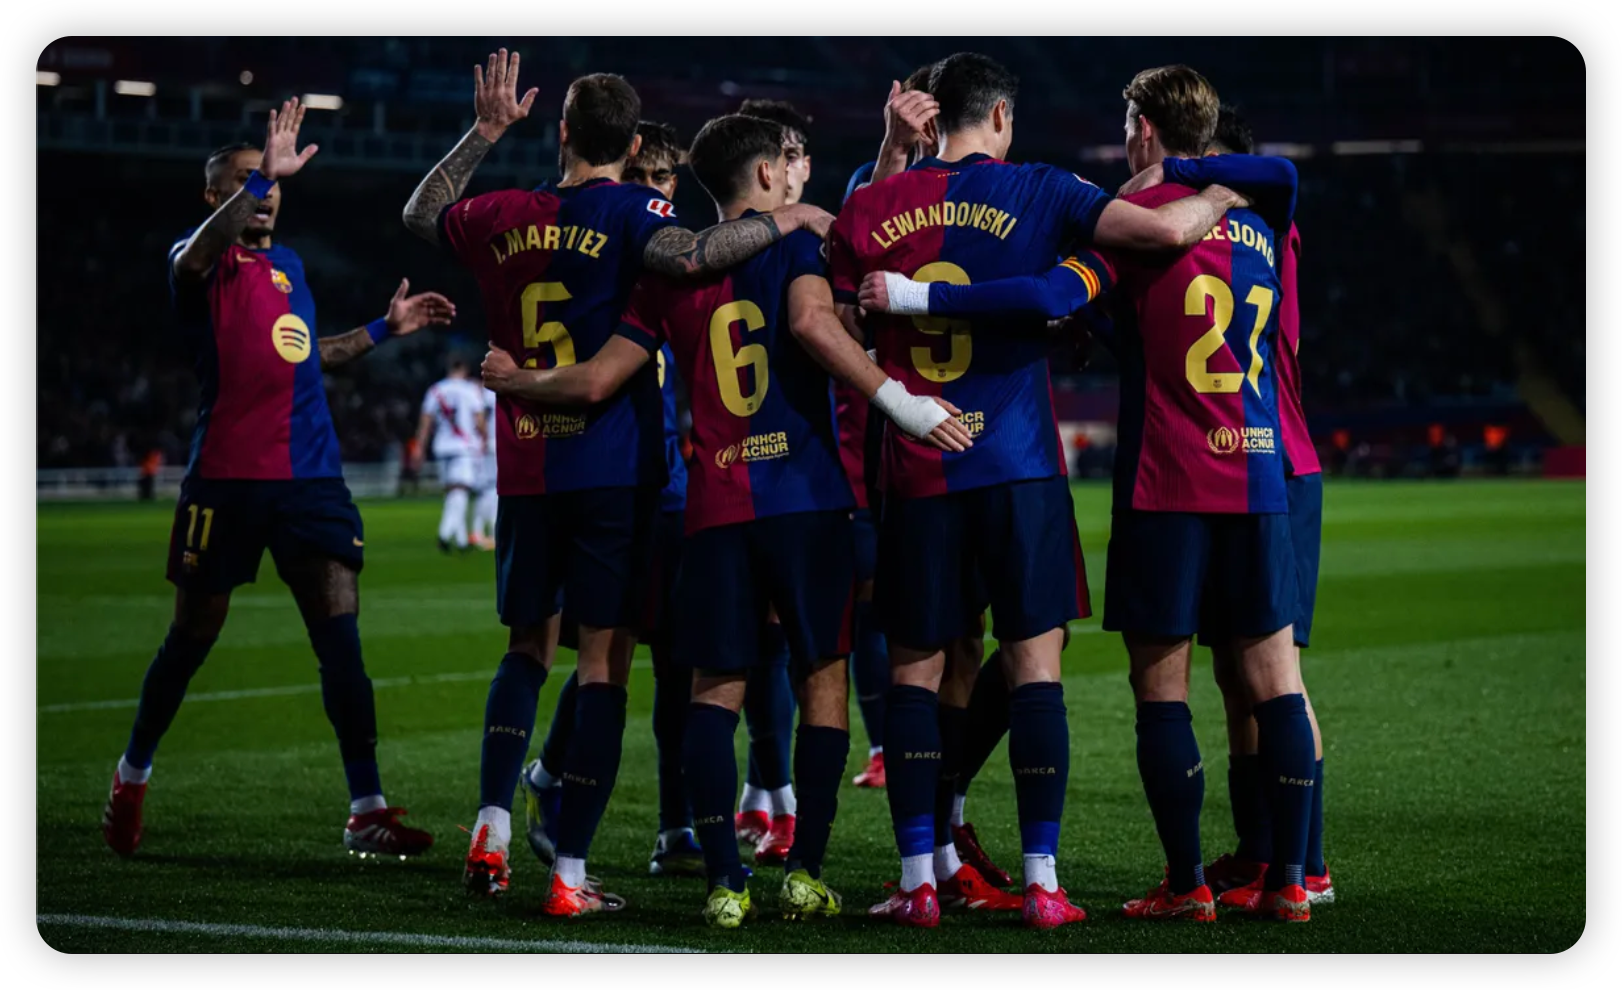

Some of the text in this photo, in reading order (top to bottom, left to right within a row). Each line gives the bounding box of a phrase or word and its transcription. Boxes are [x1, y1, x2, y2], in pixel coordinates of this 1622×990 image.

[871, 201, 1017, 249] LEWANDOWSKI
[520, 281, 577, 369] 5
[910, 261, 973, 384] 9
[1184, 274, 1274, 400] 21
[709, 299, 769, 418] 6
[741, 431, 788, 448] UNHCR
[741, 442, 789, 458] ACNUR
[1240, 426, 1275, 439] UNHCR
[1241, 438, 1276, 450] ACNUR
[186, 502, 215, 551] 11
